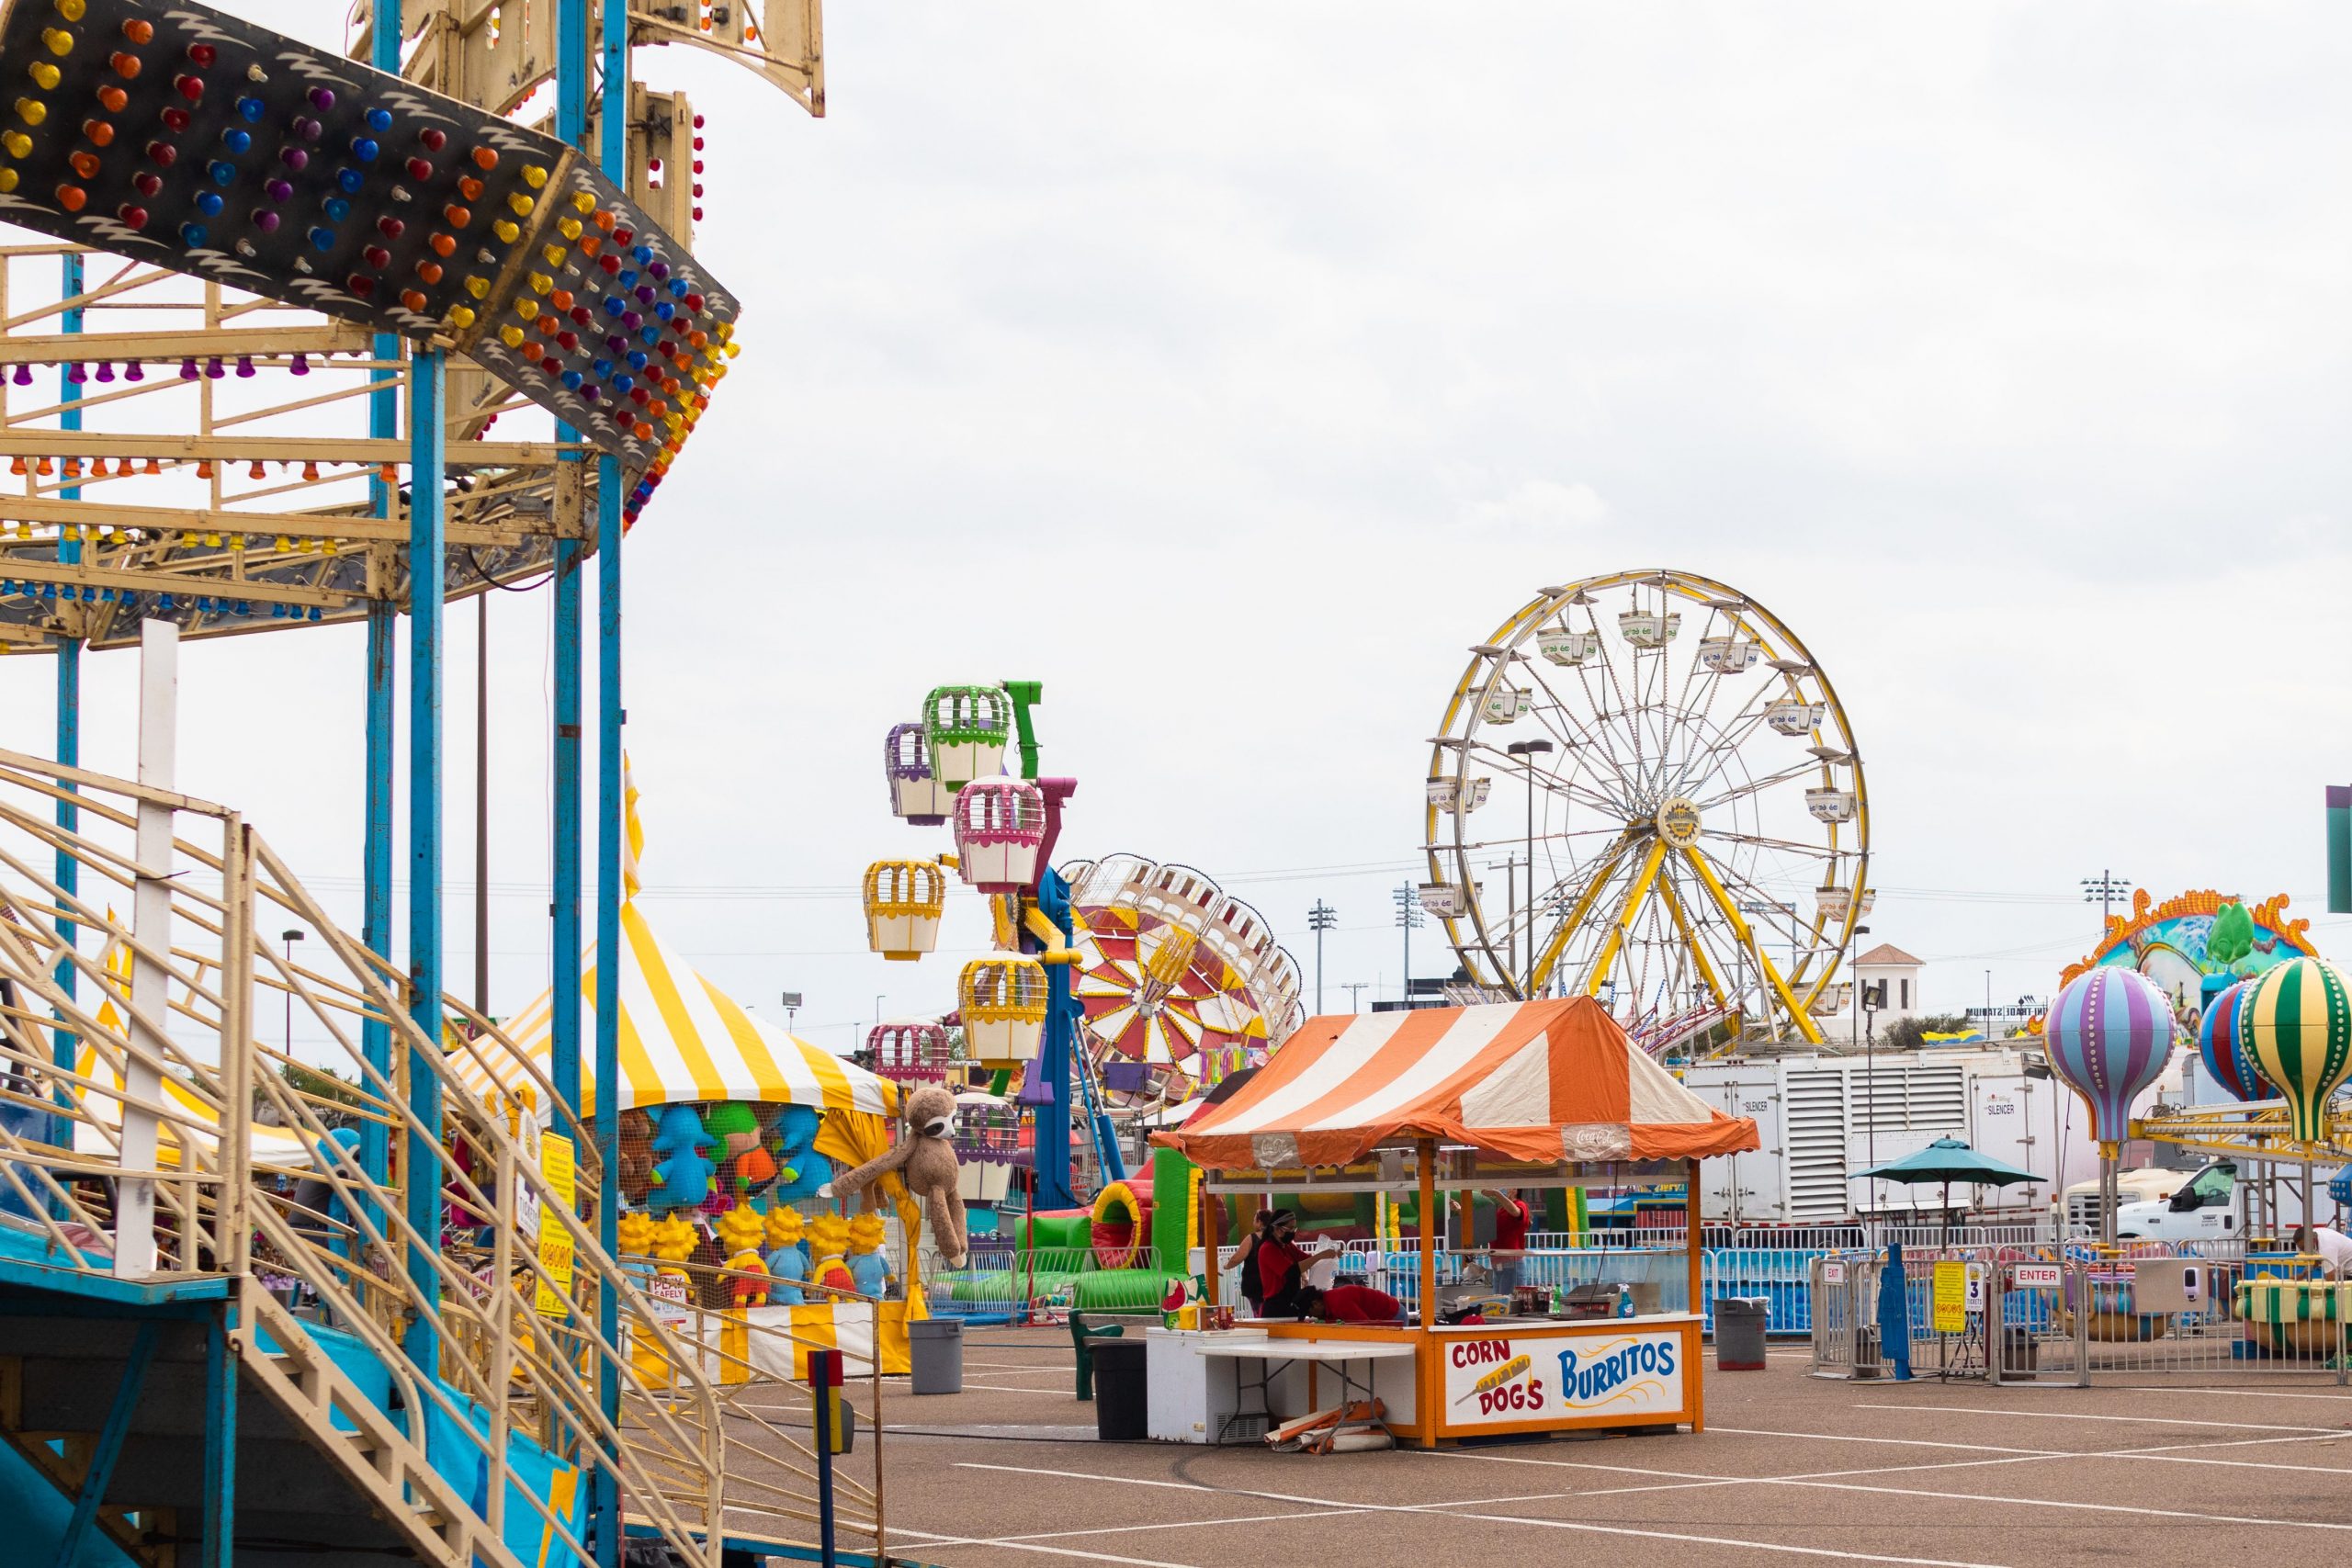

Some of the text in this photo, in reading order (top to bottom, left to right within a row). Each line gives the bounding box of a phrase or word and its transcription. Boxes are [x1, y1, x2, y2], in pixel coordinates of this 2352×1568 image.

[1746, 1101, 1768, 1112] SILENCER
[1987, 1104, 2015, 1115] SILENCER
[1828, 1268, 1838, 1278] EXIT
[2019, 1269, 2057, 1280] ENTER
[1970, 1281, 1979, 1298] 3
[1452, 1339, 1511, 1369] CORN
[1557, 1341, 1675, 1400] BURRITOS
[1478, 1379, 1544, 1416] DOGS
